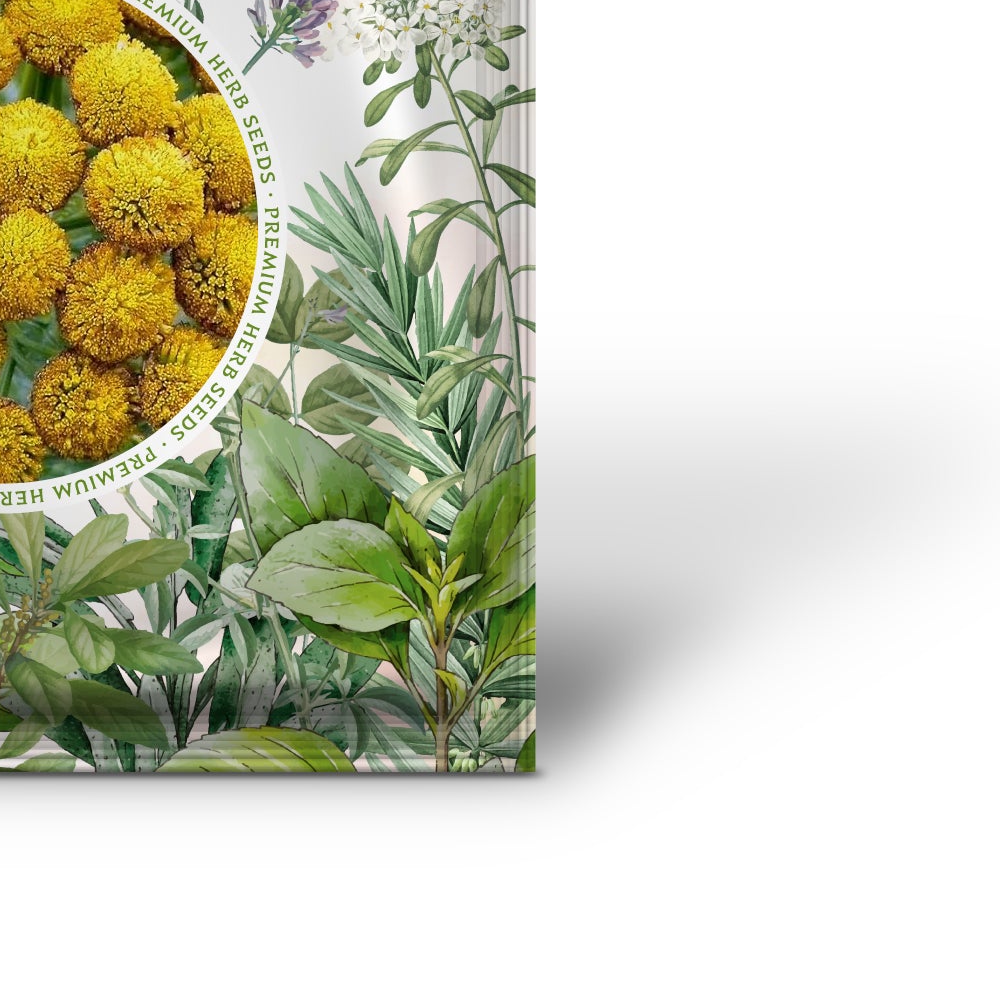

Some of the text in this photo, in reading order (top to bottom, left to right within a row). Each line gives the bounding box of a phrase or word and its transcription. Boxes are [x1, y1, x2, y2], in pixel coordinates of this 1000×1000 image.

[207, 53, 249, 110] HERB
[241, 114, 277, 185] SEEDS
[169, 206, 281, 441] PREMIUM HERB SEEDS
[51, 445, 158, 500] PREMIUM
